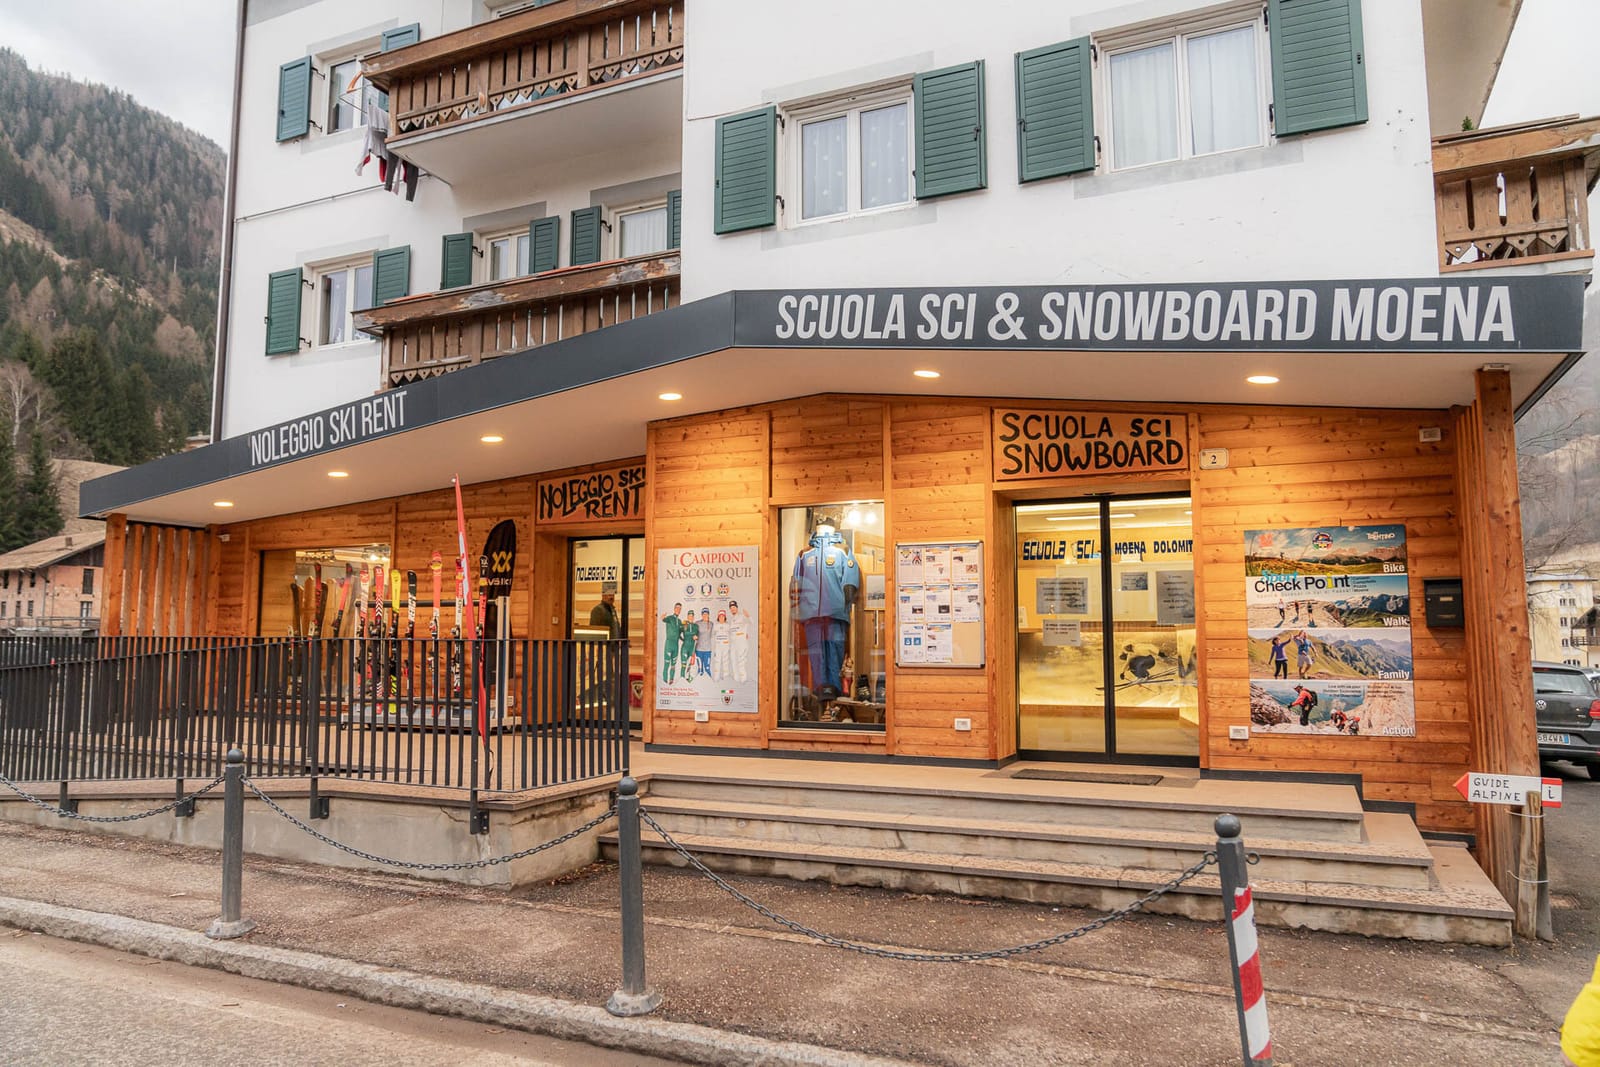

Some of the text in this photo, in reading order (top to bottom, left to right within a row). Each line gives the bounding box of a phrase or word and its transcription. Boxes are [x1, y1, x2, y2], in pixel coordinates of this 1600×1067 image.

[775, 285, 1516, 342] SCUOLA SCI & SNOWBOARD MOENA
[251, 390, 407, 466] NOLEGGIO SKI RENT
[999, 412, 1171, 442] SCUOLA SCI
[1001, 439, 1184, 475] SNOWBOARD
[1210, 455, 1218, 465] 2
[539, 467, 646, 520] NOLEGGIO SKI
[584, 481, 646, 519] RENT
[1076, 539, 1096, 560] SCI
[1114, 541, 1147, 555] MOENA
[673, 552, 744, 567] I CAMPIONI
[666, 567, 752, 580] NASCONO QUI!
[1383, 563, 1405, 573] Bike
[1254, 578, 1301, 593] Check
[1304, 571, 1351, 590] Point
[1261, 568, 1298, 584] Sport
[1383, 616, 1408, 626] Walk
[1378, 670, 1410, 681] Family
[1383, 726, 1414, 736] Action
[1473, 778, 1510, 788] GUIDE
[1472, 790, 1521, 802] ALPINE
